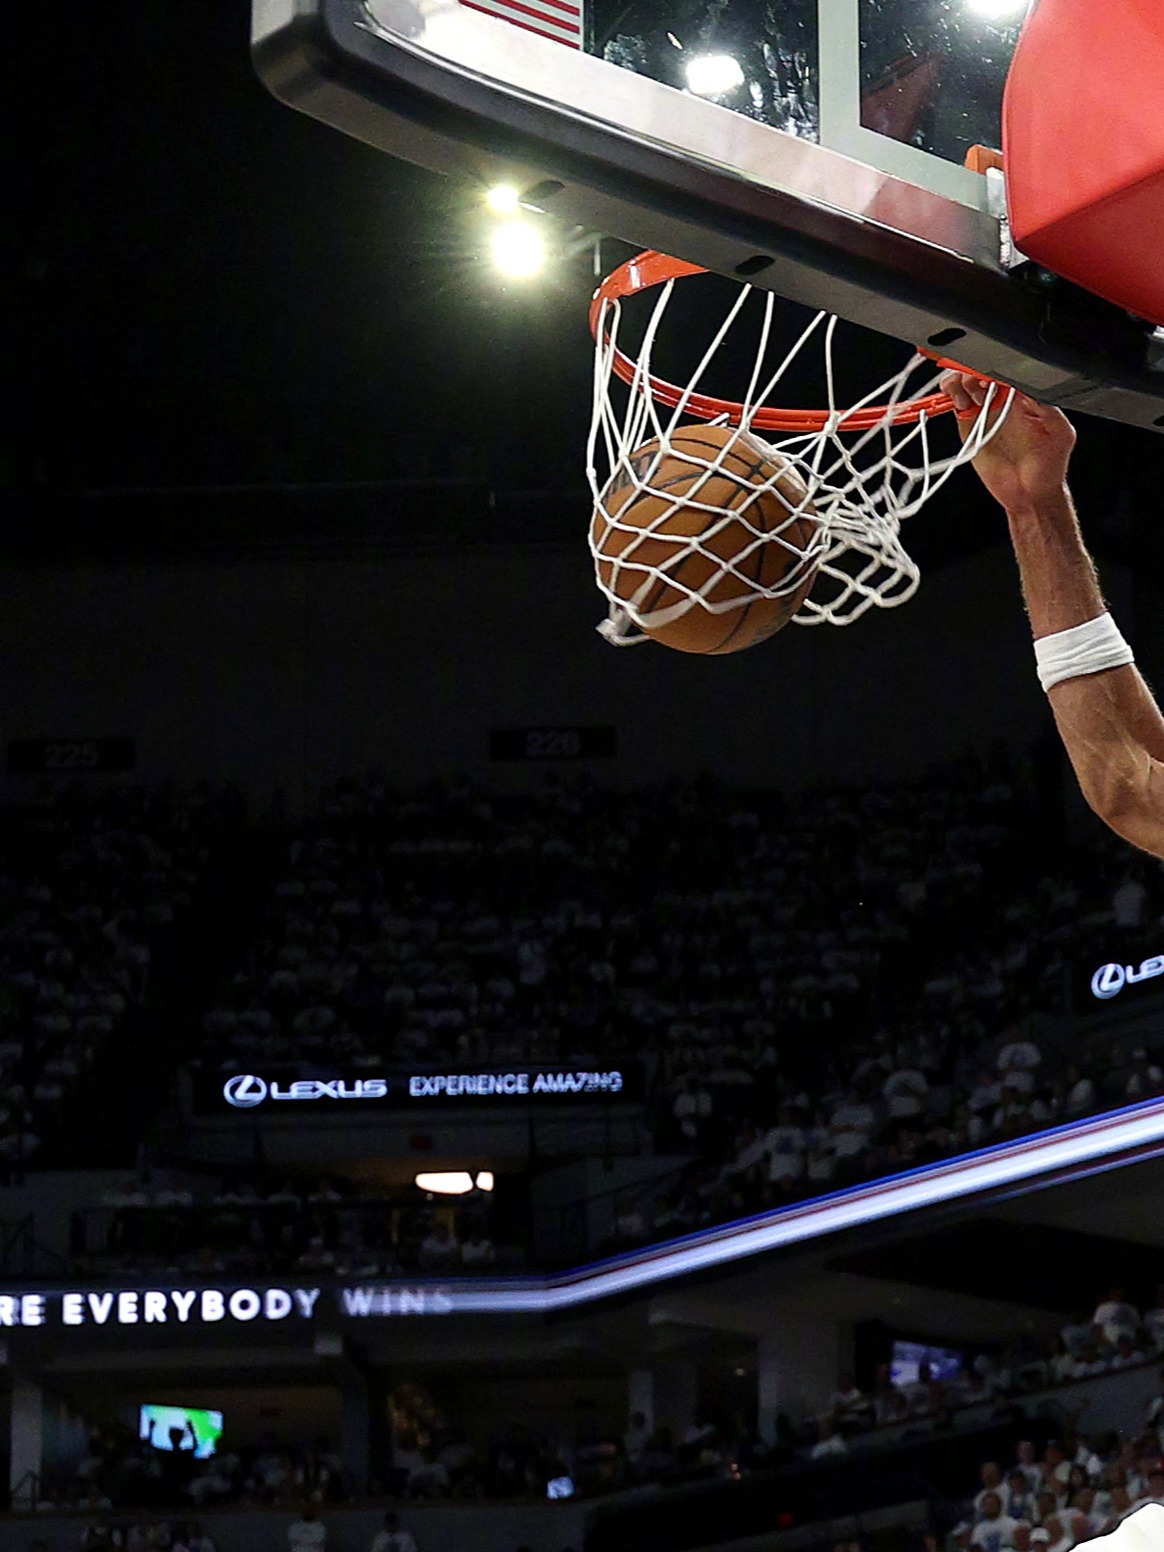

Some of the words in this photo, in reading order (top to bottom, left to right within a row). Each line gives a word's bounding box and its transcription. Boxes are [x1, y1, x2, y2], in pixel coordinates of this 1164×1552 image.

[270, 1079, 388, 1100] LEXUS
[409, 1073, 529, 1097] EXPERIENCE
[62, 1288, 321, 1325] EVERYBODY
